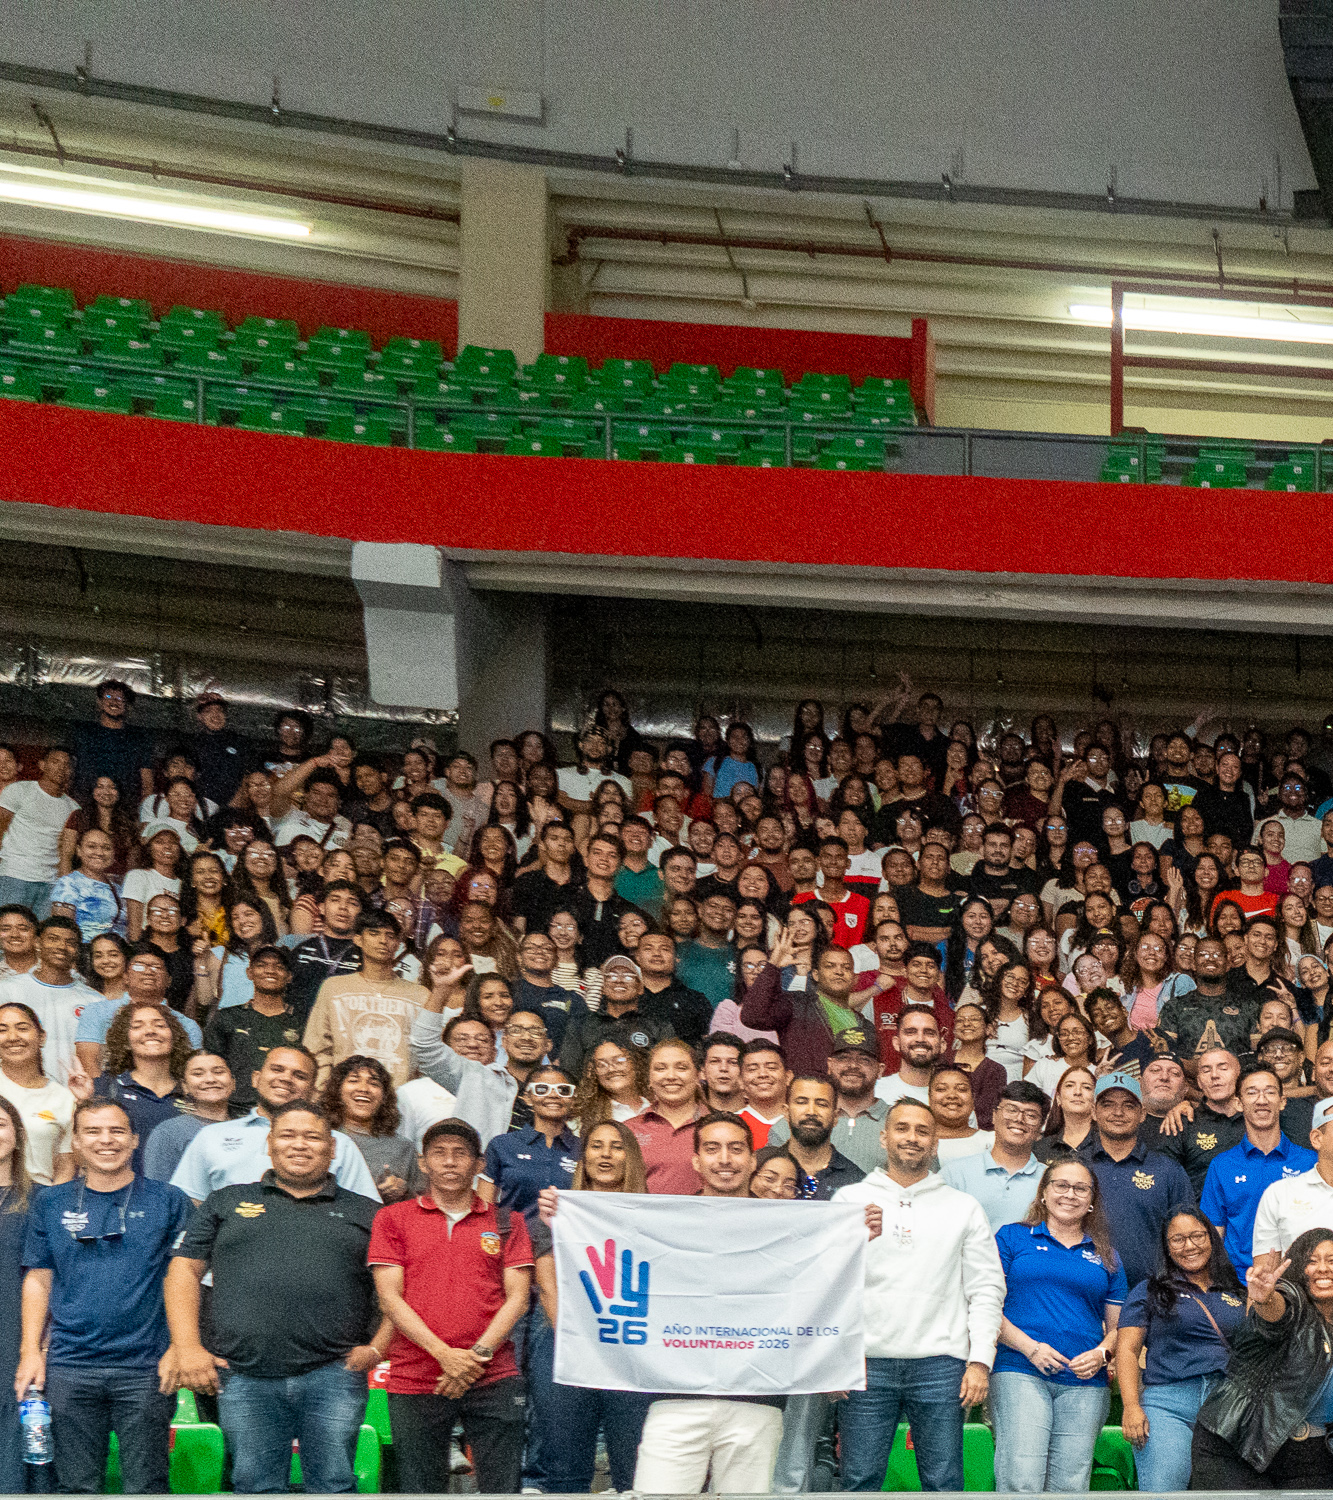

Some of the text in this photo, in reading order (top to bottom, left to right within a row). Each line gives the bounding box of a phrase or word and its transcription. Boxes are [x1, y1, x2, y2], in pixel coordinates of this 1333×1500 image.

[597, 1318, 649, 1345] 26
[663, 1324, 839, 1337] AÑO INTERNACIONAL DE LOS
[662, 1339, 790, 1350] VOLUNTARIOS 2026
